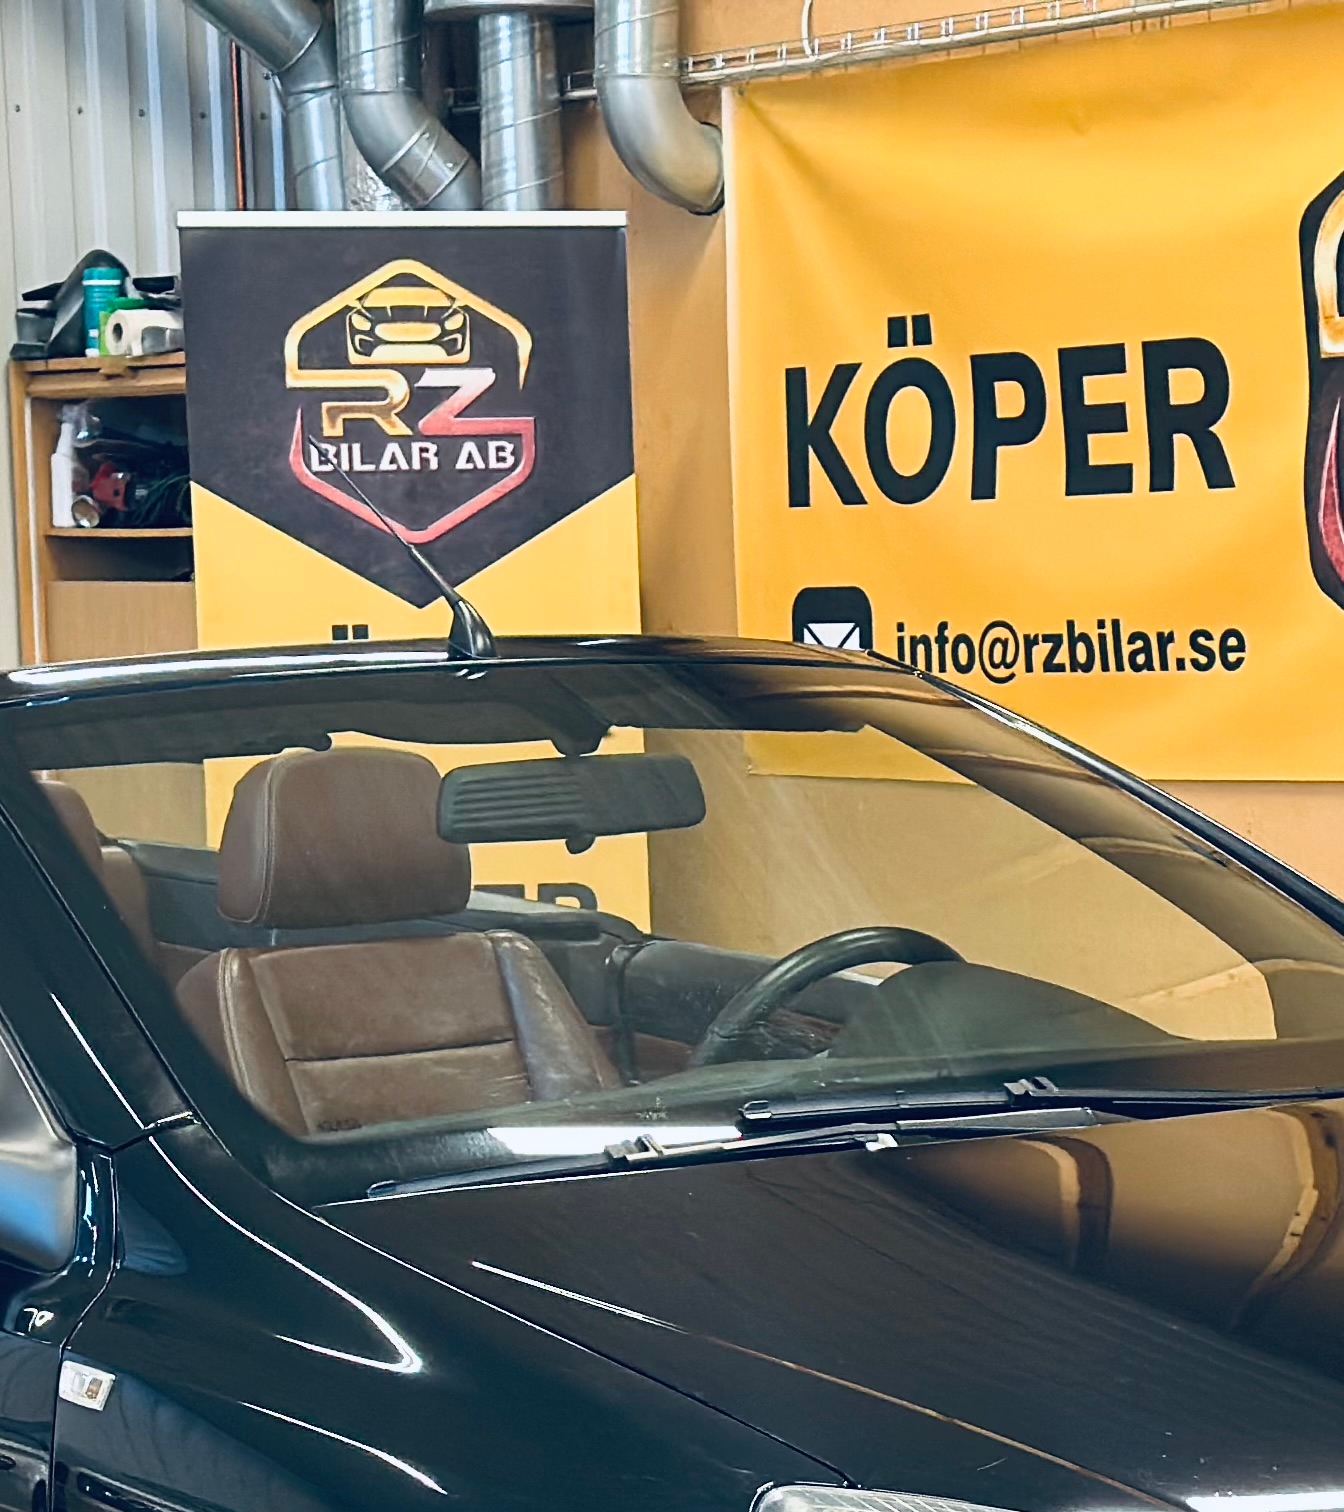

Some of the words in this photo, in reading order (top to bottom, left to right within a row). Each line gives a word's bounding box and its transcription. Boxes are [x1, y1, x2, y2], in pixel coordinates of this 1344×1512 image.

[285, 368, 536, 437] RZ
[785, 313, 1236, 509] KÖPER
[309, 441, 439, 473] BILAR
[455, 440, 515, 471] AB
[896, 618, 1246, 685] info@rzbilar.se
